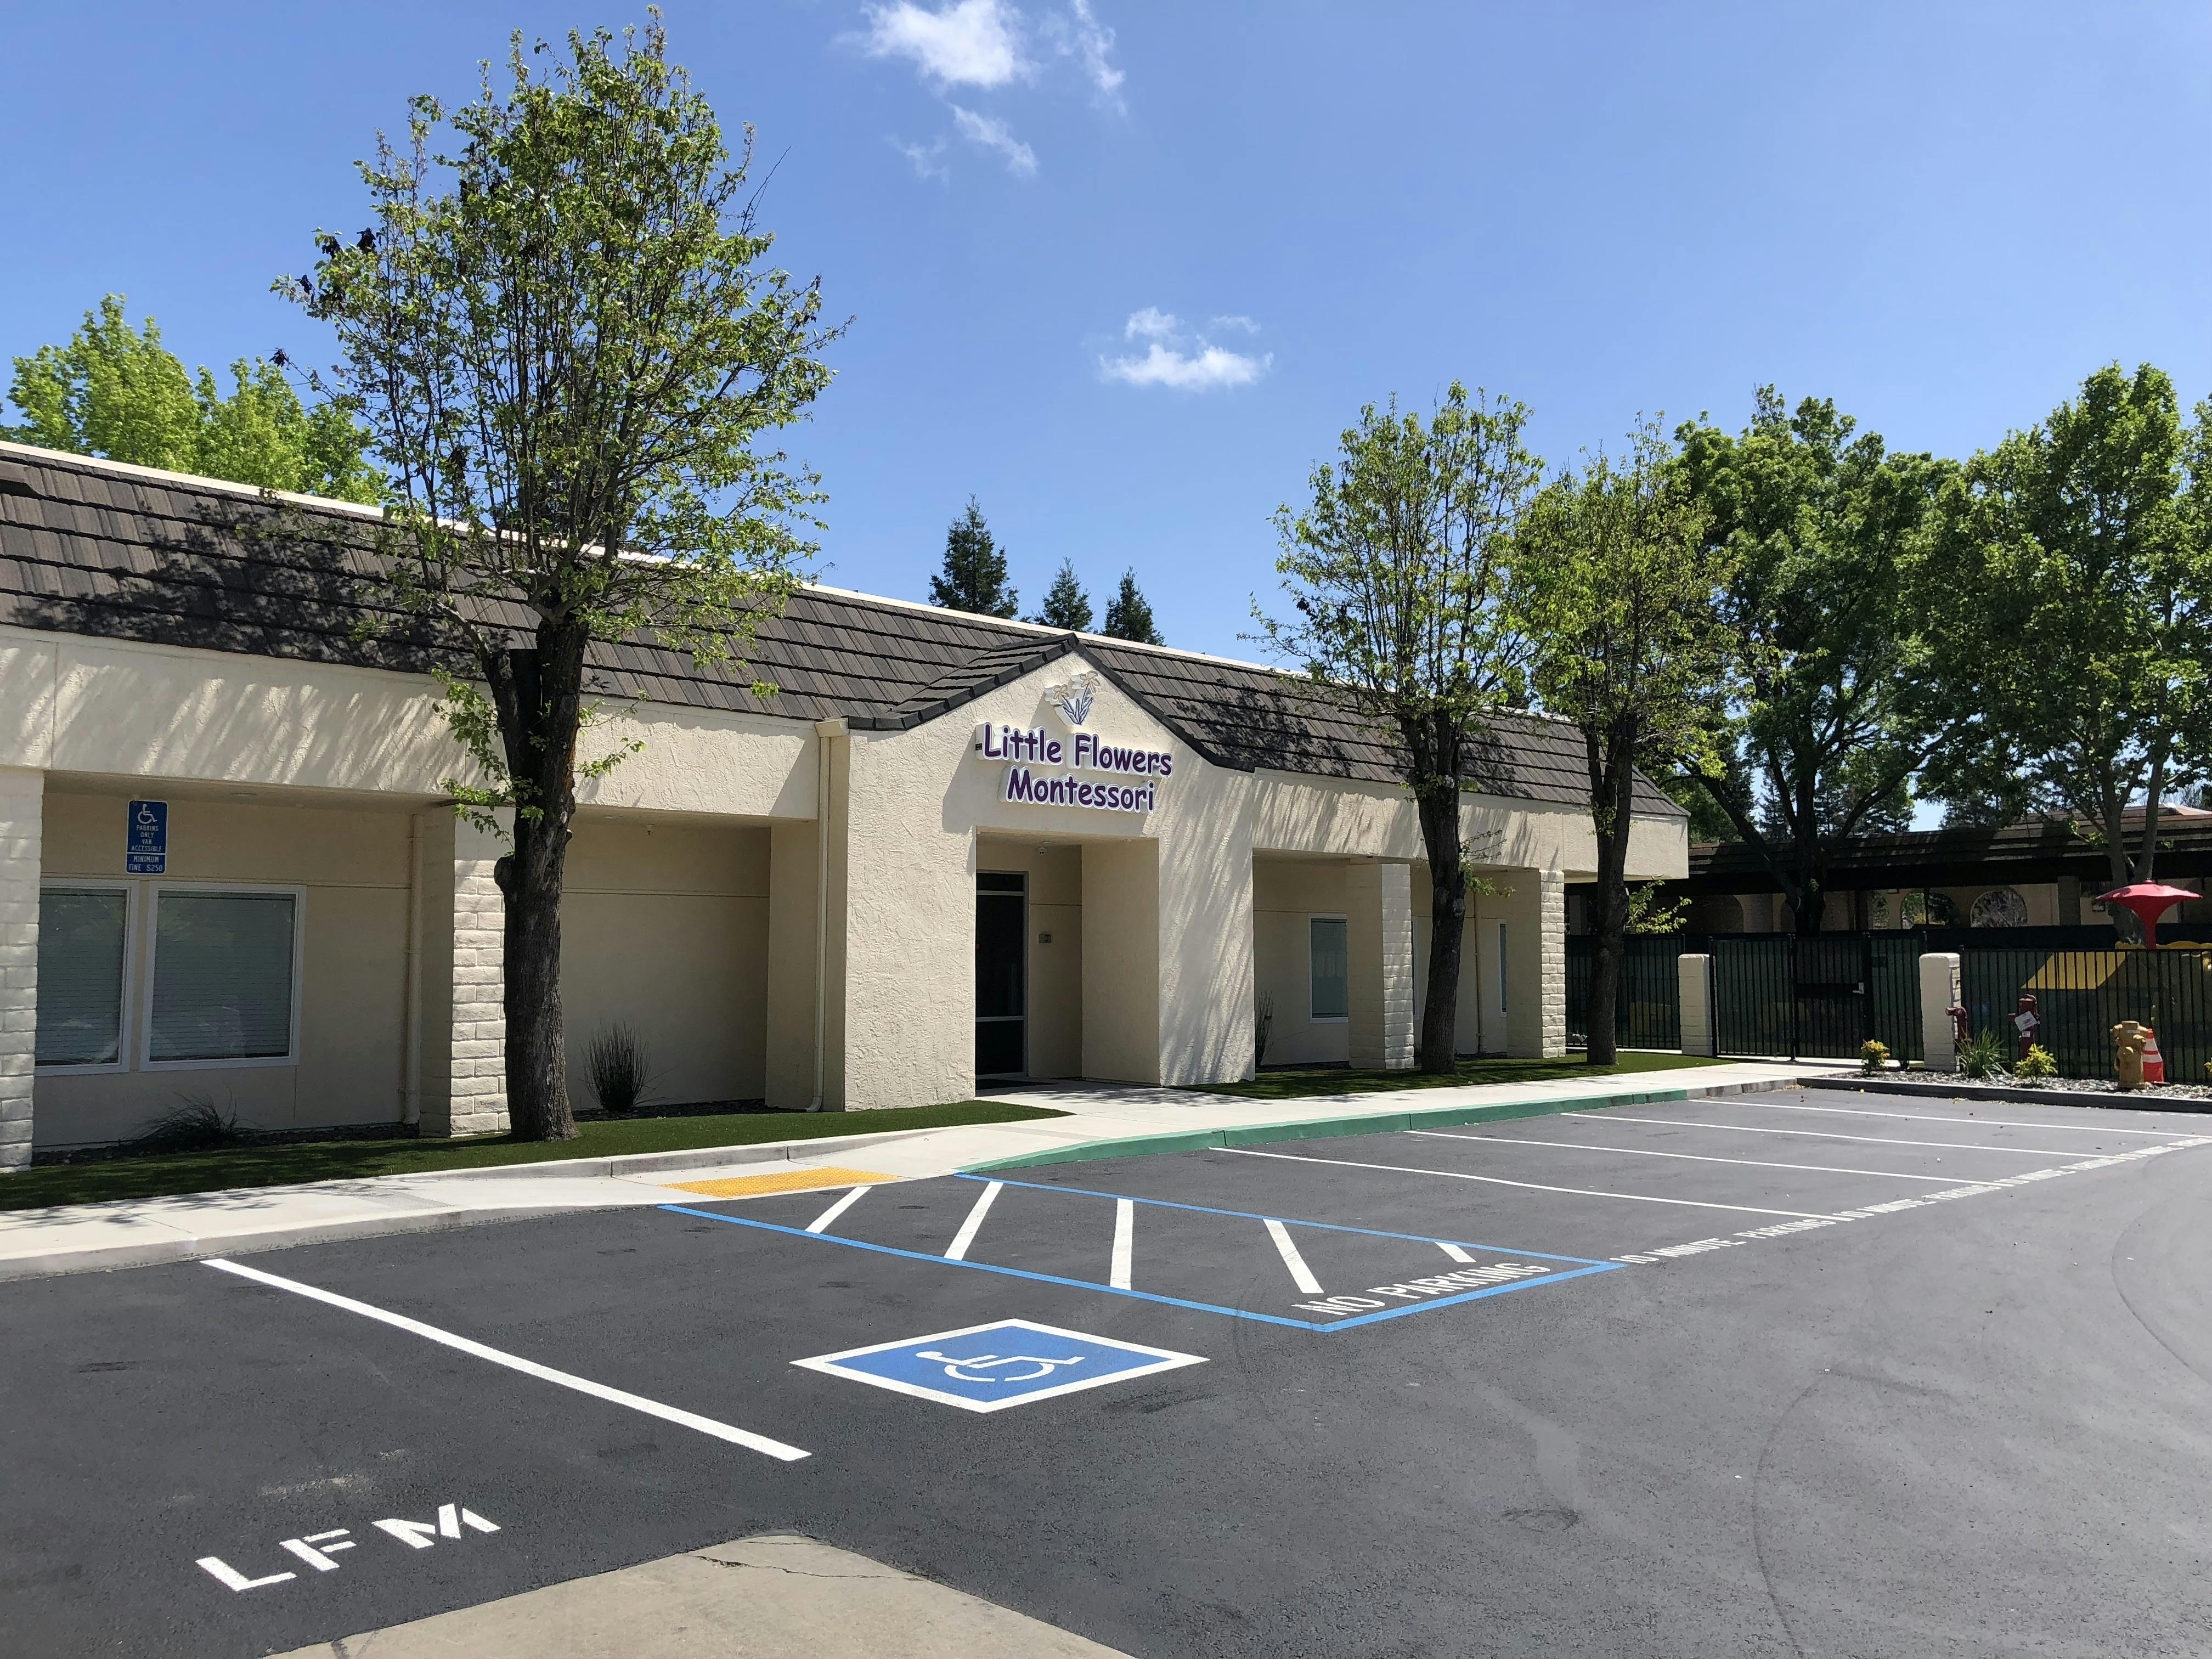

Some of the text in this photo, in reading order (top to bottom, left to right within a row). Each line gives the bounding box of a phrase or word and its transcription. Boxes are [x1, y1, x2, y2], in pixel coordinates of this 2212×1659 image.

[984, 723, 1172, 776] Little Flowers
[1007, 768, 1154, 812] Montessori
[1609, 1255, 1660, 1264] 10
[1733, 1218, 1837, 1239] PARKING
[1290, 1263, 1551, 1316] NO PARKING
